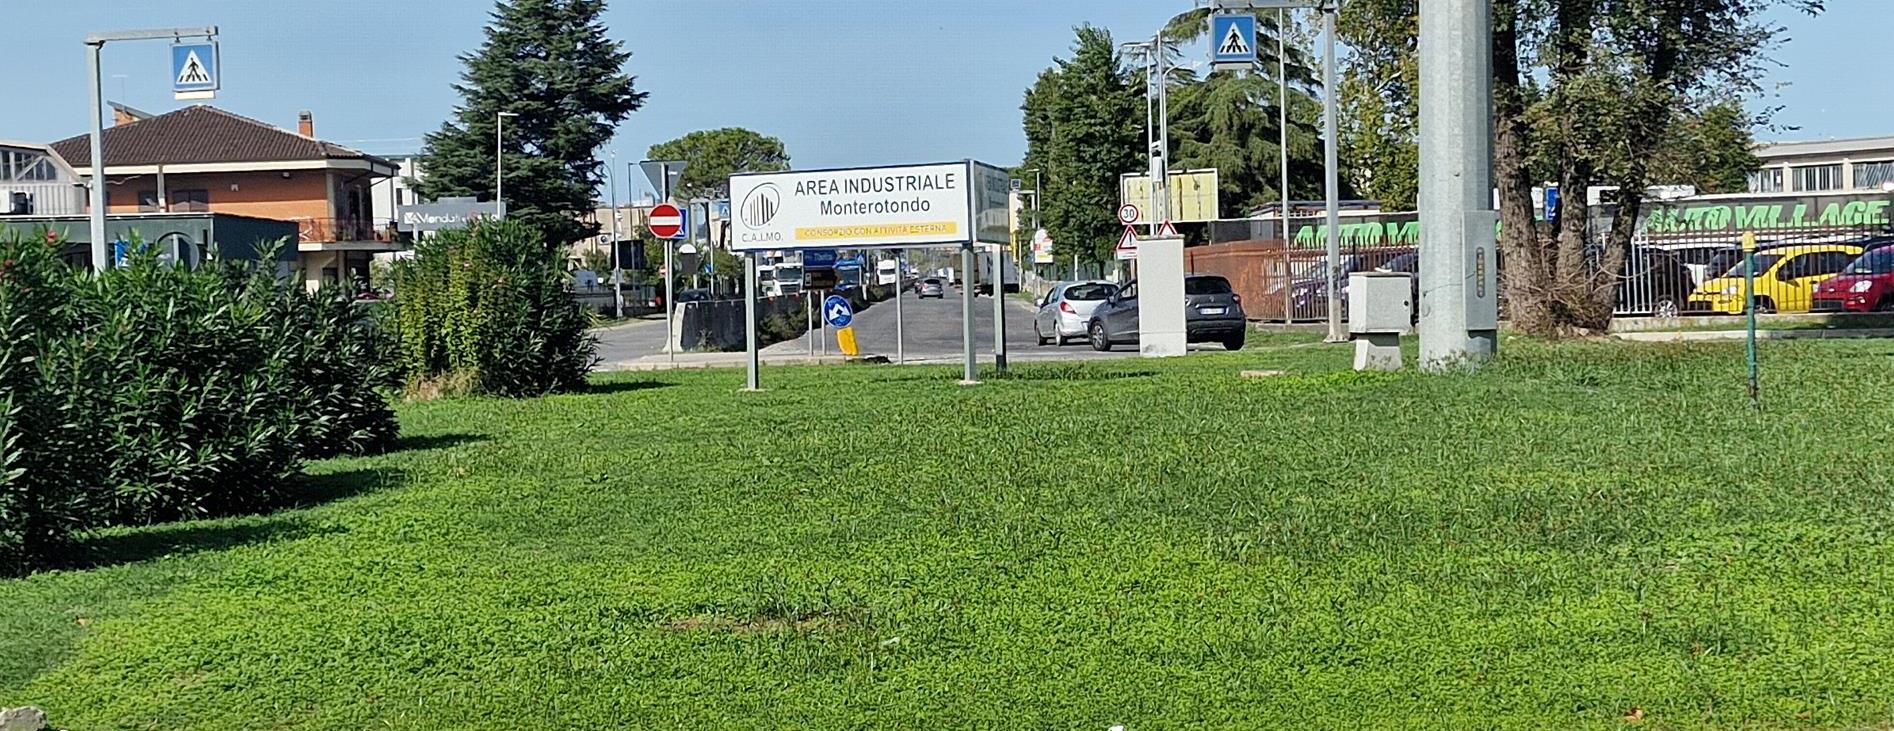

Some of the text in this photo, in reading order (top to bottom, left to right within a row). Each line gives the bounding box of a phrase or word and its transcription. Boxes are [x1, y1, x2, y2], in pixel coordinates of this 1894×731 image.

[795, 173, 956, 196] AREA INDUSTRIALE
[820, 197, 931, 216] Monterotondo
[1123, 208, 1135, 219] 30
[804, 226, 853, 238] CONSORZIO
[853, 226, 872, 237] CON
